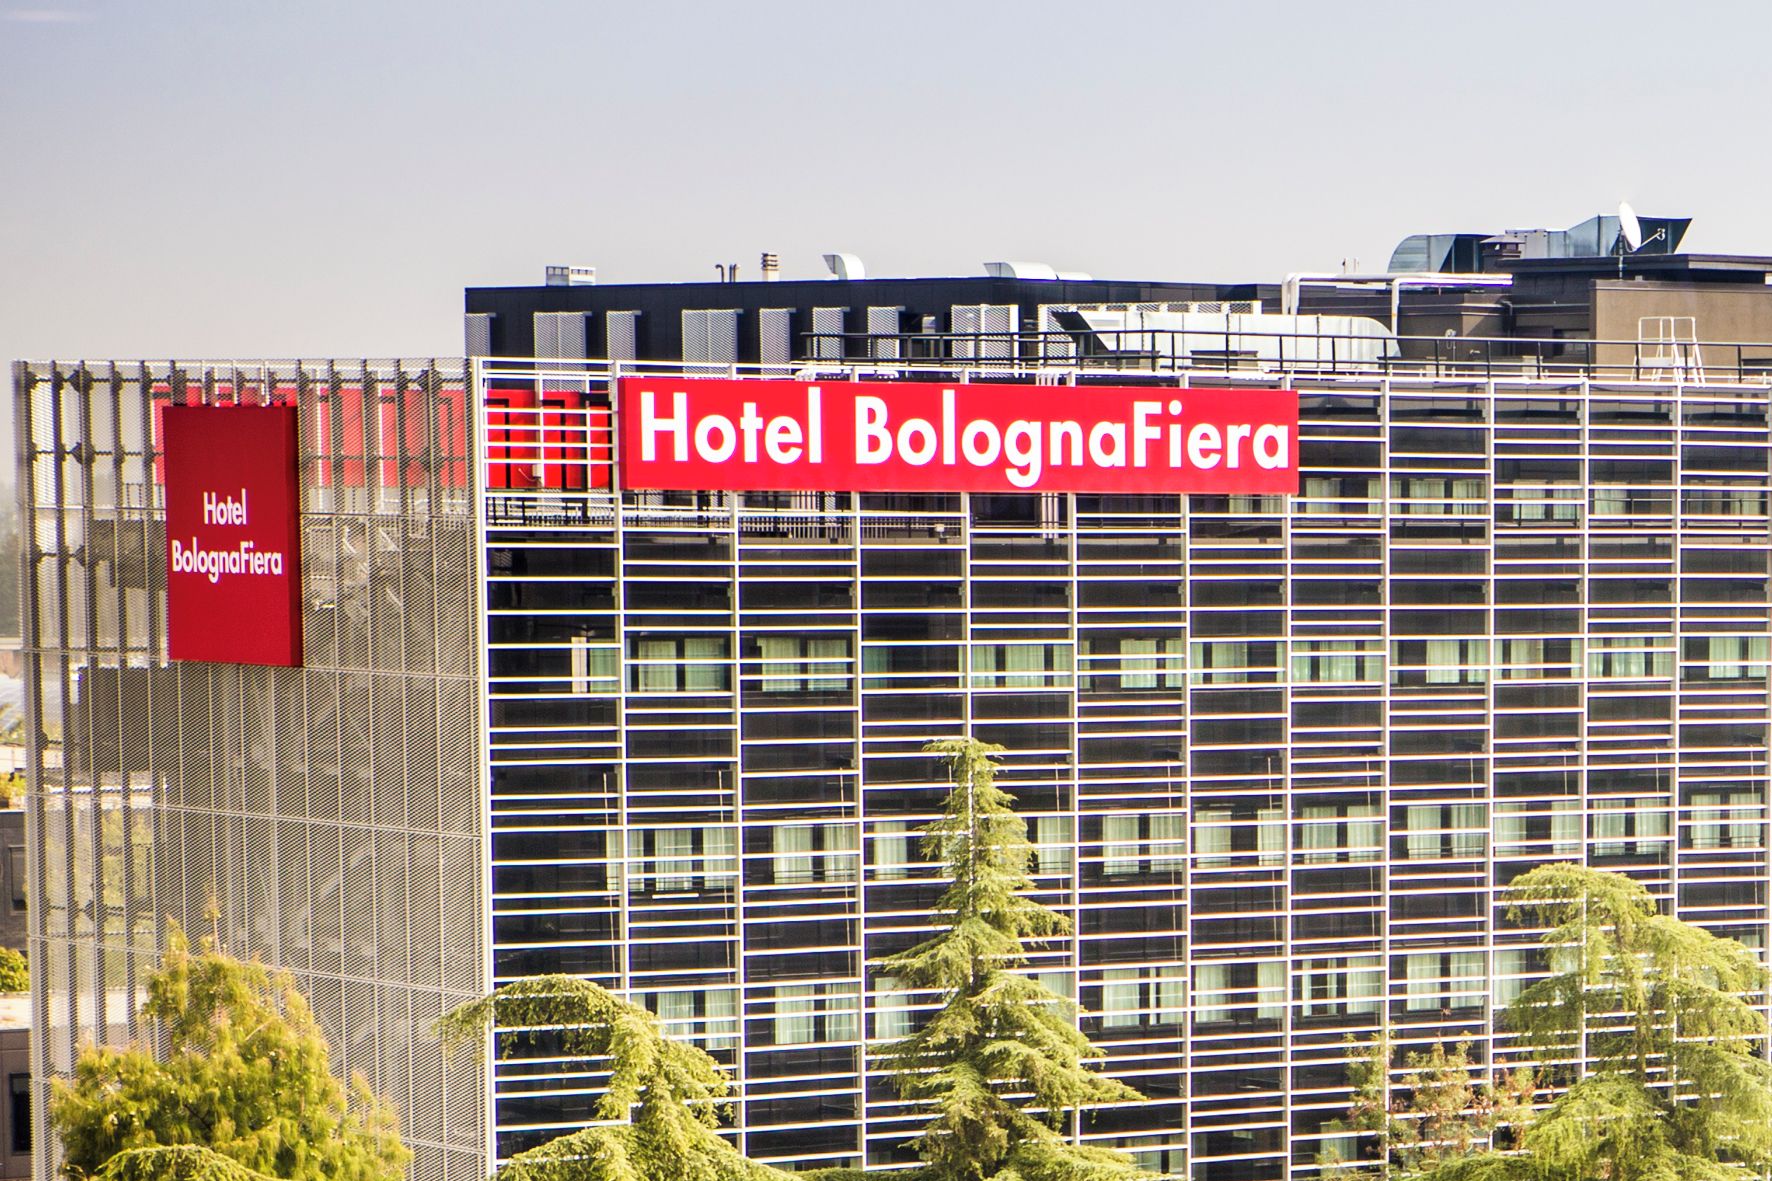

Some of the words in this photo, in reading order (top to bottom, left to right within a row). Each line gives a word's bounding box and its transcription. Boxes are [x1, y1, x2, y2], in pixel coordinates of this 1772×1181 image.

[641, 387, 821, 464] Hotel
[855, 389, 1288, 488] BolognaFiera
[203, 488, 247, 525] Hotel
[172, 536, 282, 583] BolognaFiera
